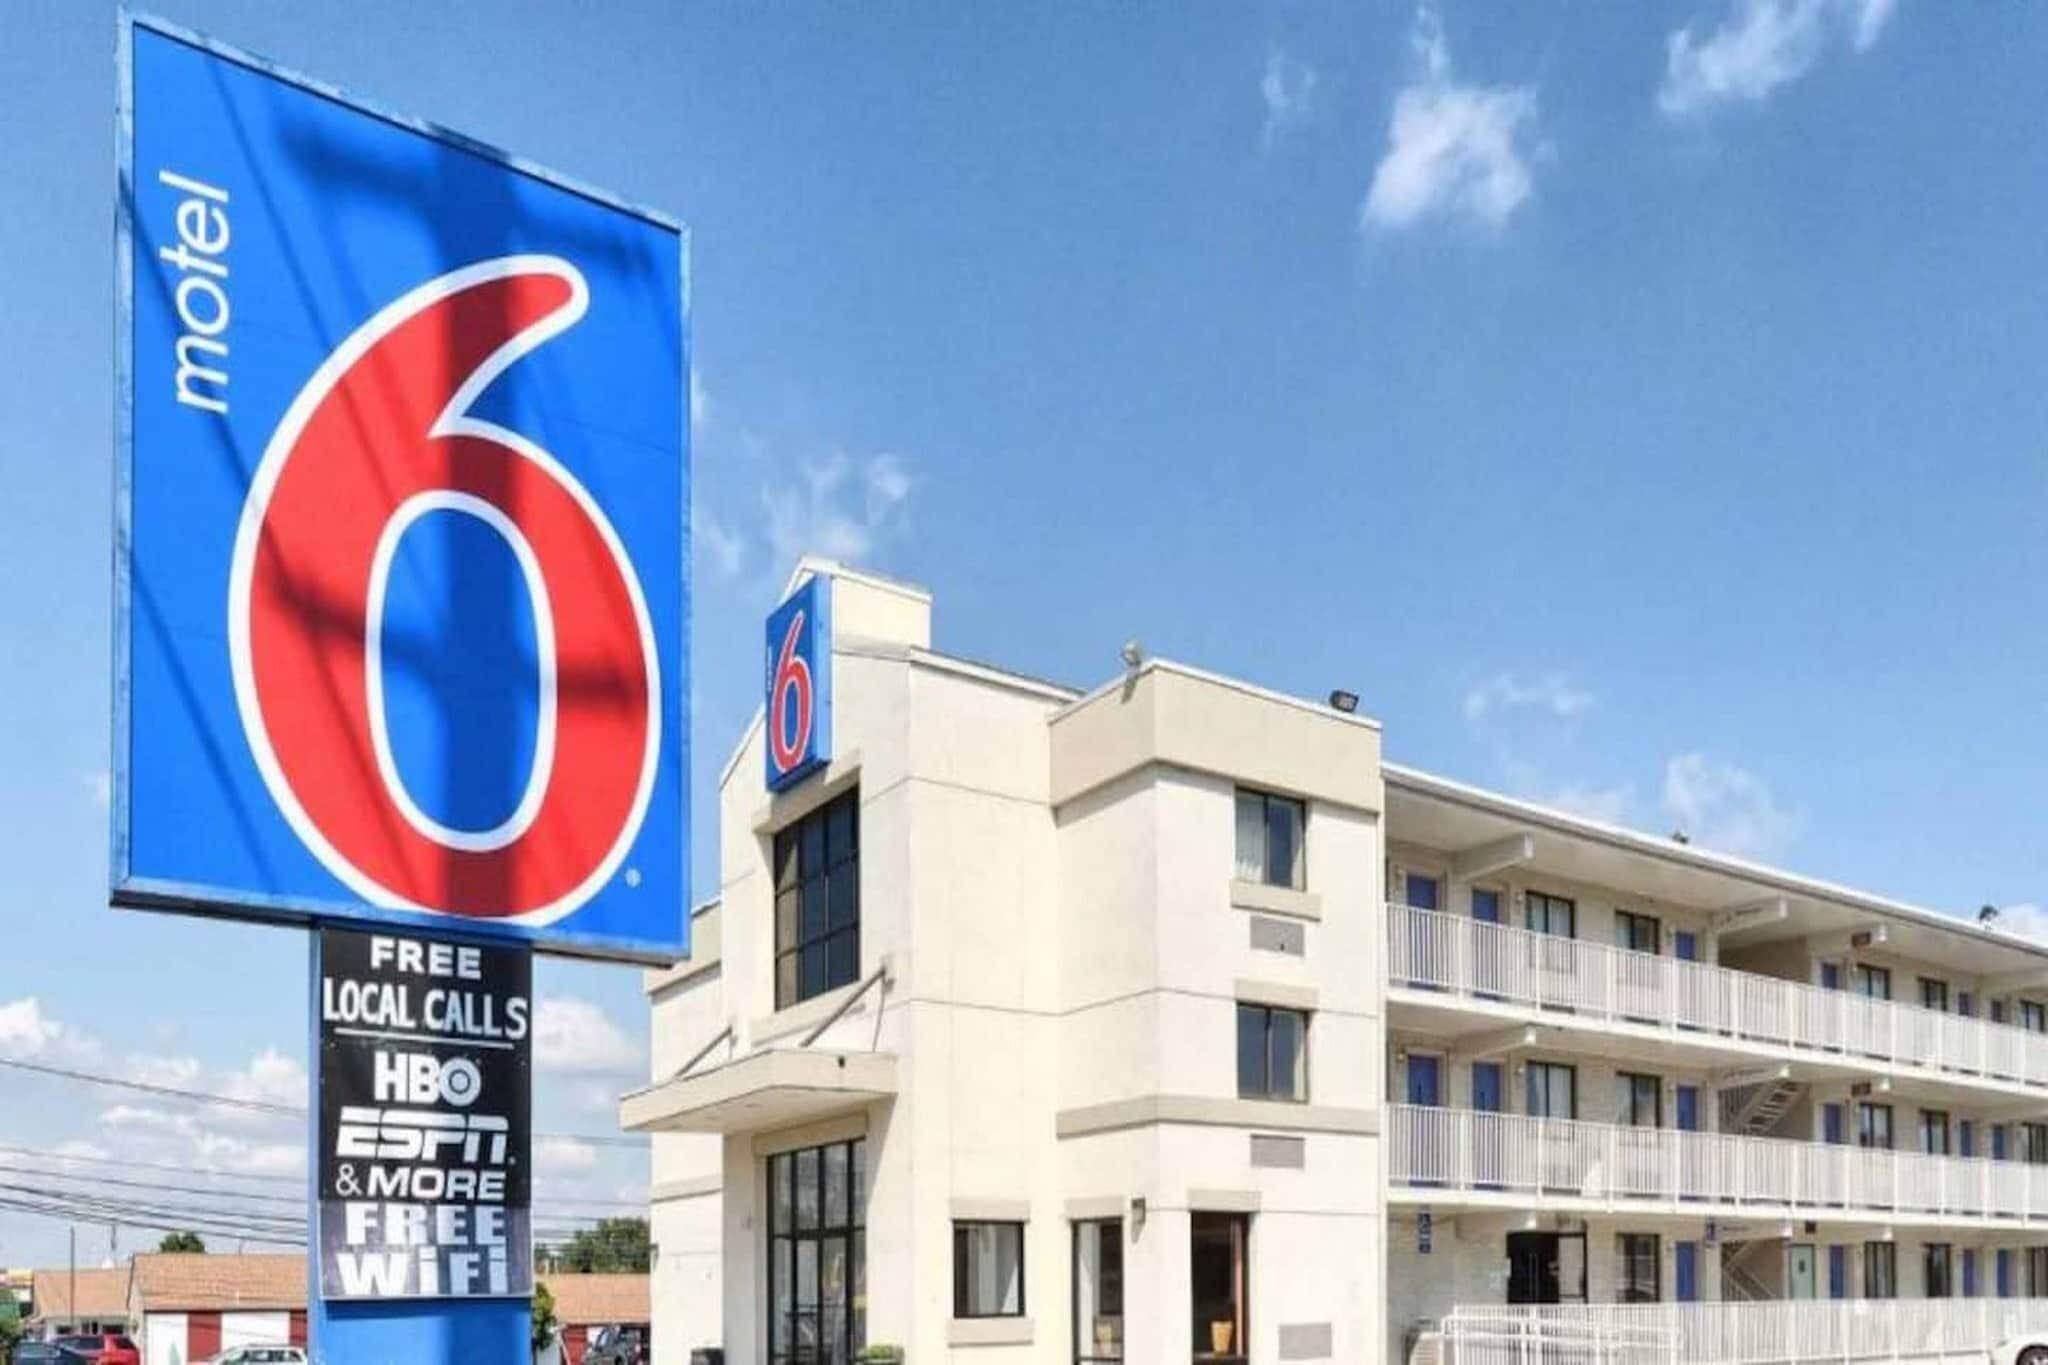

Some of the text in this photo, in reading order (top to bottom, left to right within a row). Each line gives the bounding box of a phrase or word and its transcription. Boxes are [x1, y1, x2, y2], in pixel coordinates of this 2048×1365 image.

[159, 169, 664, 927] motel 6
[770, 609, 813, 774] 6
[370, 935, 482, 980] FREE
[323, 977, 528, 1040] LOCAL CALLS
[374, 1050, 482, 1107] HBO
[335, 1163, 506, 1200] & MORE
[345, 1202, 507, 1245] FREE
